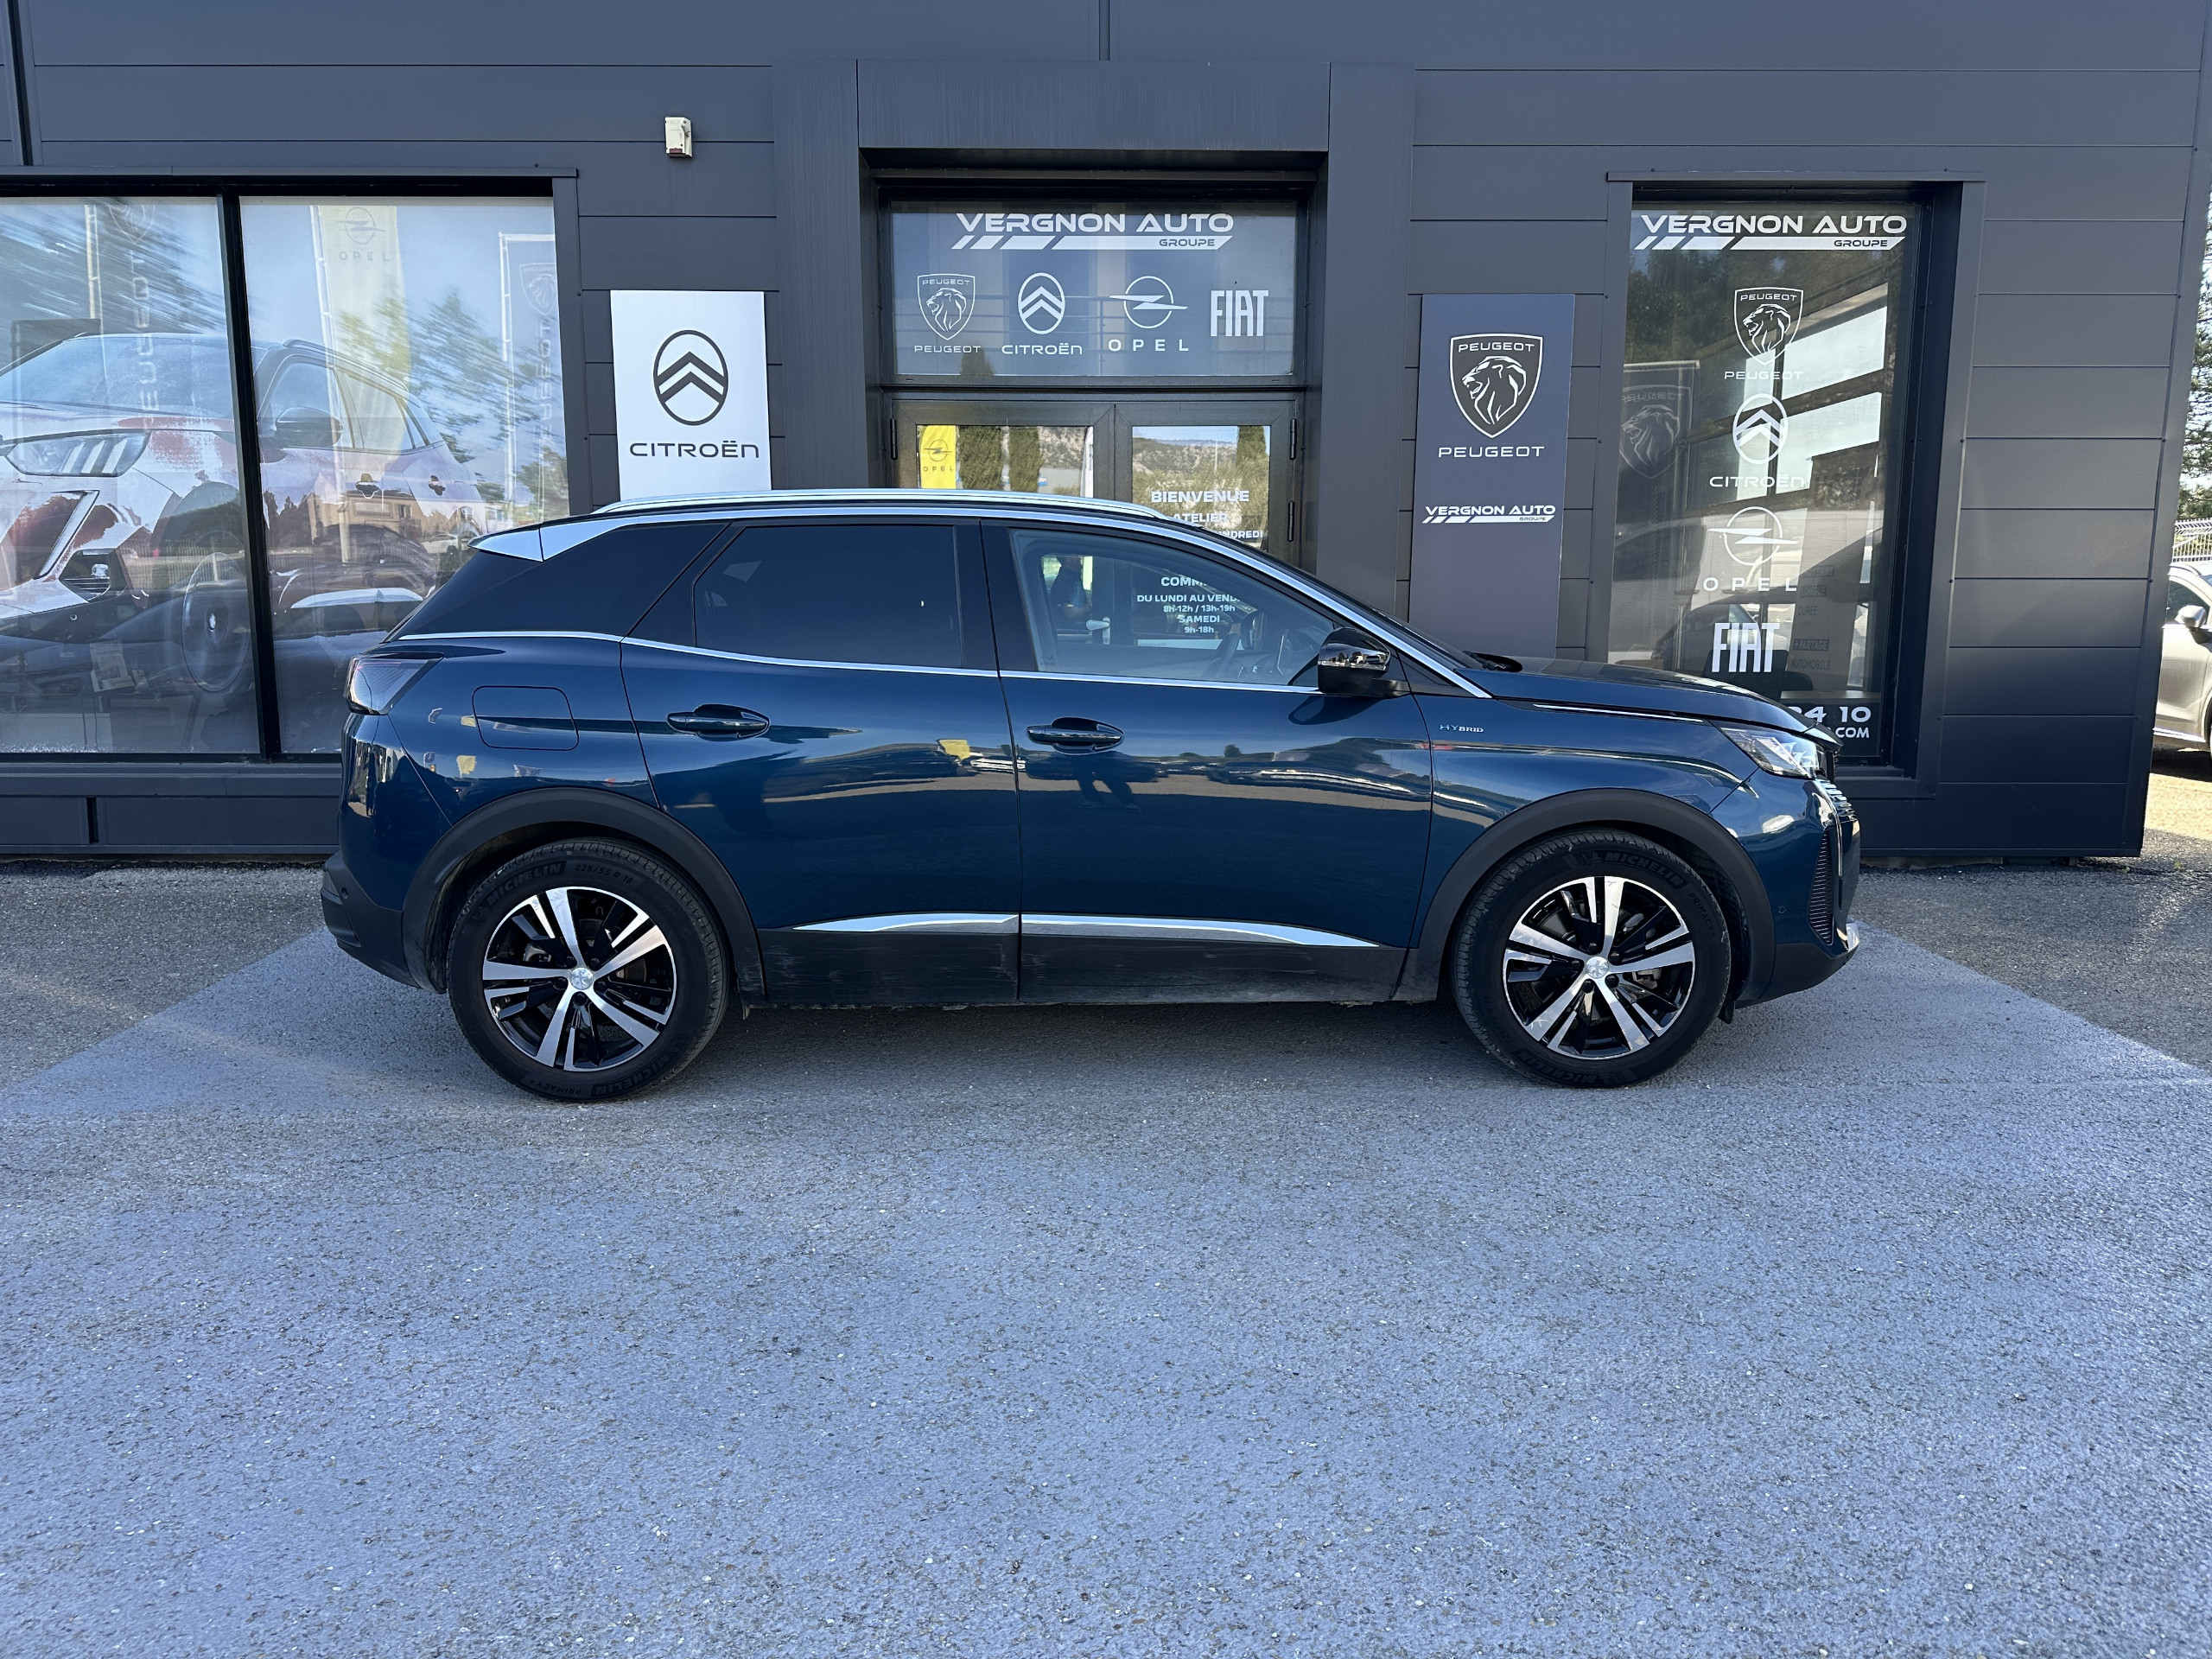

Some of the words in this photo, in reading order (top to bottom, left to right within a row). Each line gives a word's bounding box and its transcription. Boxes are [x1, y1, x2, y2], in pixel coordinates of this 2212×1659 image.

[956, 213, 1125, 232] VERGNON
[1135, 213, 1234, 232] AUTO
[1641, 214, 1802, 234] VERGNON
[1811, 214, 1907, 234] AUTO
[1158, 238, 1216, 248] GROUPE
[1833, 238, 1889, 248] GROUPE
[1739, 293, 1798, 302] PEUGEOT
[1211, 289, 1269, 337] FIAT
[1108, 339, 1189, 352] OPEL
[1458, 342, 1535, 353] PEUGEOT
[1724, 371, 1804, 380] PEUGEOT
[1438, 446, 1546, 458] PEUGEOT
[1151, 490, 1249, 504] BIENVENUE
[1425, 505, 1505, 516] VERGNON
[1509, 505, 1556, 515] AUTO
[1702, 577, 1797, 593] OPEL
[1712, 622, 1780, 672] FIAT
[1839, 706, 1872, 723] 10
[1440, 724, 1484, 733] HYBRID
[1827, 727, 1870, 739] COM
[574, 864, 611, 877] 225/55
[1605, 852, 1684, 887] MICHELIN
[486, 863, 562, 906] MICHELIN
